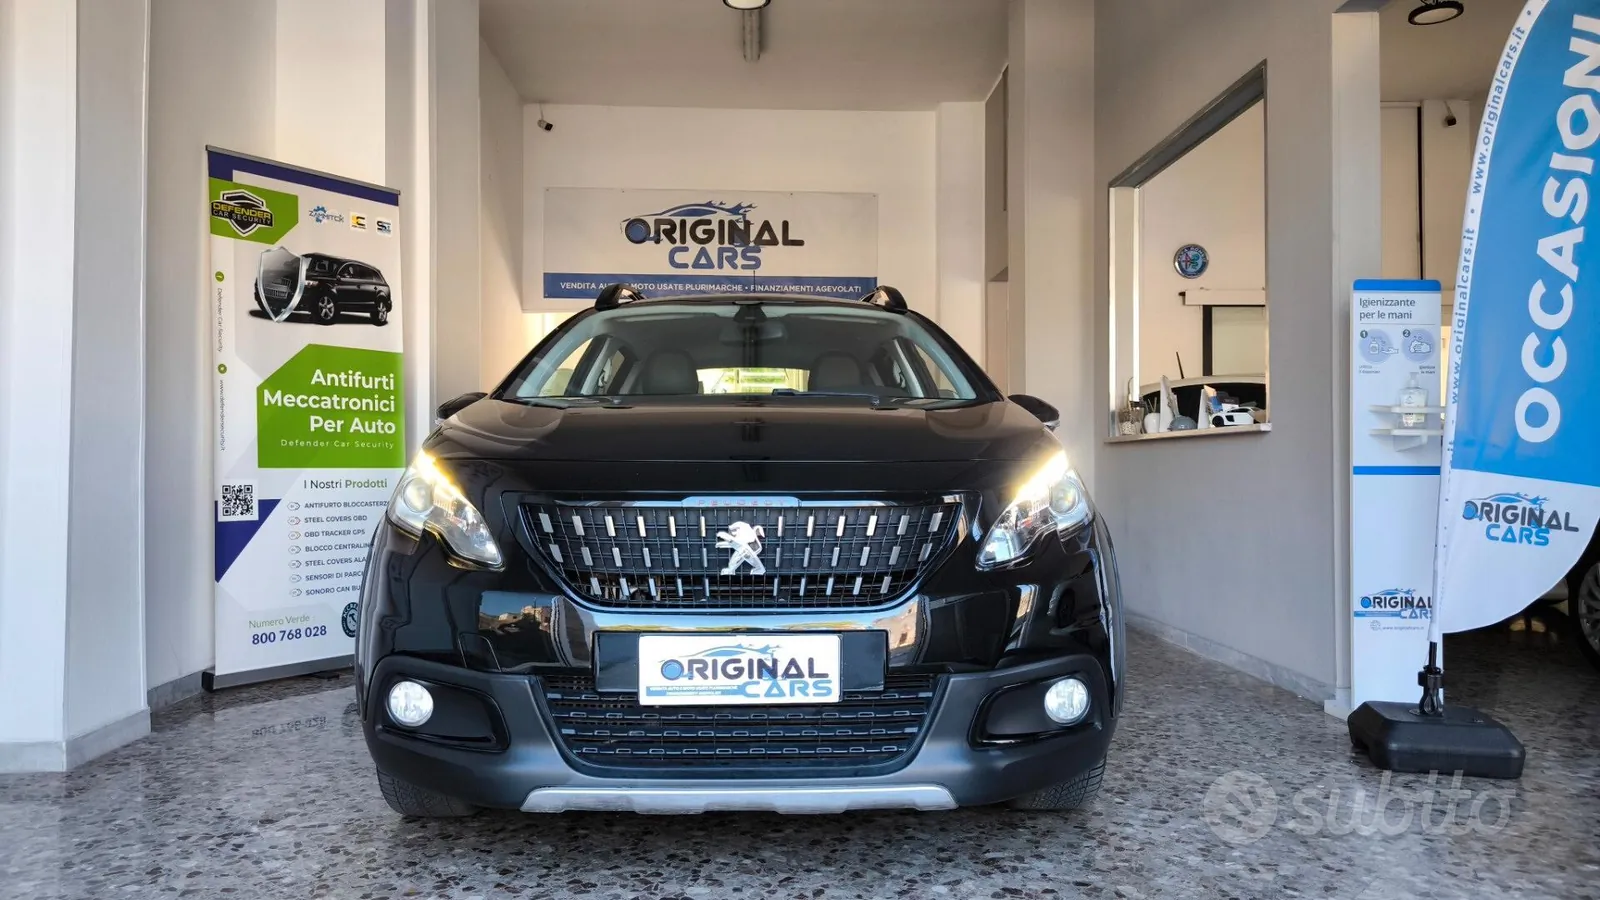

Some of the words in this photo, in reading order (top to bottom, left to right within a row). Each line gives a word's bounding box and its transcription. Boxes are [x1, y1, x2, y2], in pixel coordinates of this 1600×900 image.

[1473, 26, 1525, 194] www.originalcars.it
[213, 203, 271, 219] DEFENDER
[213, 209, 229, 218] CAR
[232, 213, 271, 225] SECURITY
[624, 218, 805, 247] ORIGINAL
[1515, 14, 1600, 443] OCCASIONI
[668, 246, 762, 270] CARS
[560, 282, 597, 290] VENDITA
[631, 282, 655, 290] MOTO
[657, 283, 684, 291] USATE
[685, 284, 743, 292] PLURIMARCHE
[750, 284, 814, 293] FINANZIAMENTI
[815, 285, 862, 293] AGEVOLATI
[1359, 297, 1416, 308] Igienizzante
[1359, 311, 1375, 321] per
[1377, 310, 1386, 319] le
[1388, 310, 1413, 319] mani
[1452, 228, 1475, 404] www.originalcars.it
[310, 369, 395, 390] Antifurti
[263, 389, 396, 412] Meccatronici
[309, 415, 344, 432] Per
[349, 417, 396, 434] Auto
[280, 439, 330, 448] Defender
[334, 440, 350, 448] Car
[354, 441, 395, 450] Security
[310, 479, 342, 489] Nostri
[345, 479, 388, 489] Prodotti
[1462, 500, 1579, 533] ORIGINAL
[1485, 523, 1550, 547] CARS
[334, 543, 371, 551] CENTRALIN
[305, 573, 334, 581] SENSORI
[305, 588, 335, 596] SONORO
[1360, 596, 1432, 609] ORIGINAL
[248, 618, 284, 629] Numero
[285, 614, 310, 624] Verde
[252, 631, 276, 645] 800
[279, 628, 302, 642] 768
[305, 625, 327, 638] 028
[660, 657, 829, 681] ORIGINAL
[739, 680, 833, 698] CARS
